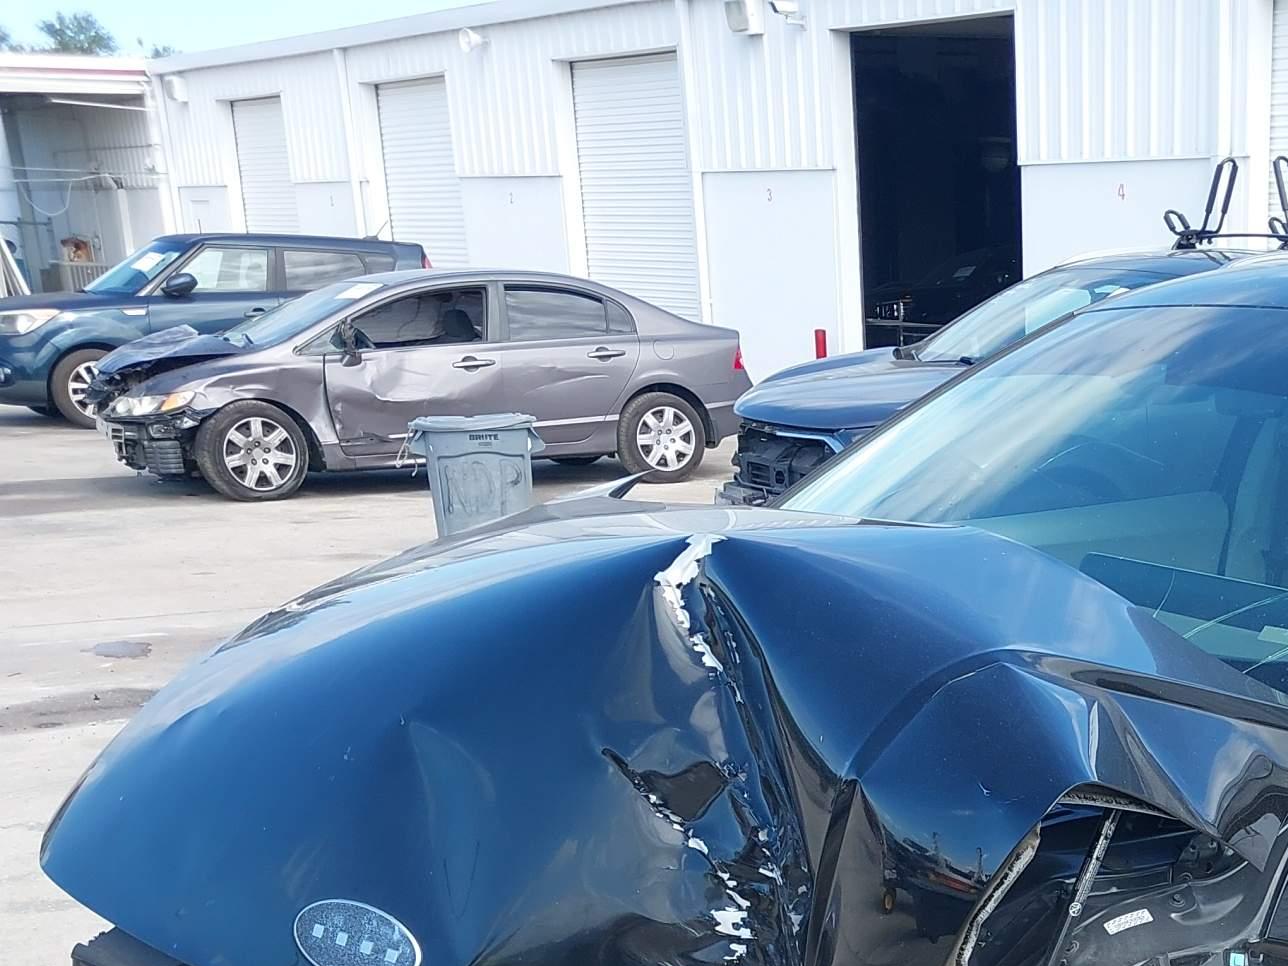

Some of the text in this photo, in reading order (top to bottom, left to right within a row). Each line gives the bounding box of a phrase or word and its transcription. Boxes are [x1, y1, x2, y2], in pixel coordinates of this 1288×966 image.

[766, 187, 773, 202] 3
[1117, 183, 1126, 201] 4
[468, 433, 500, 441] BRUTE
